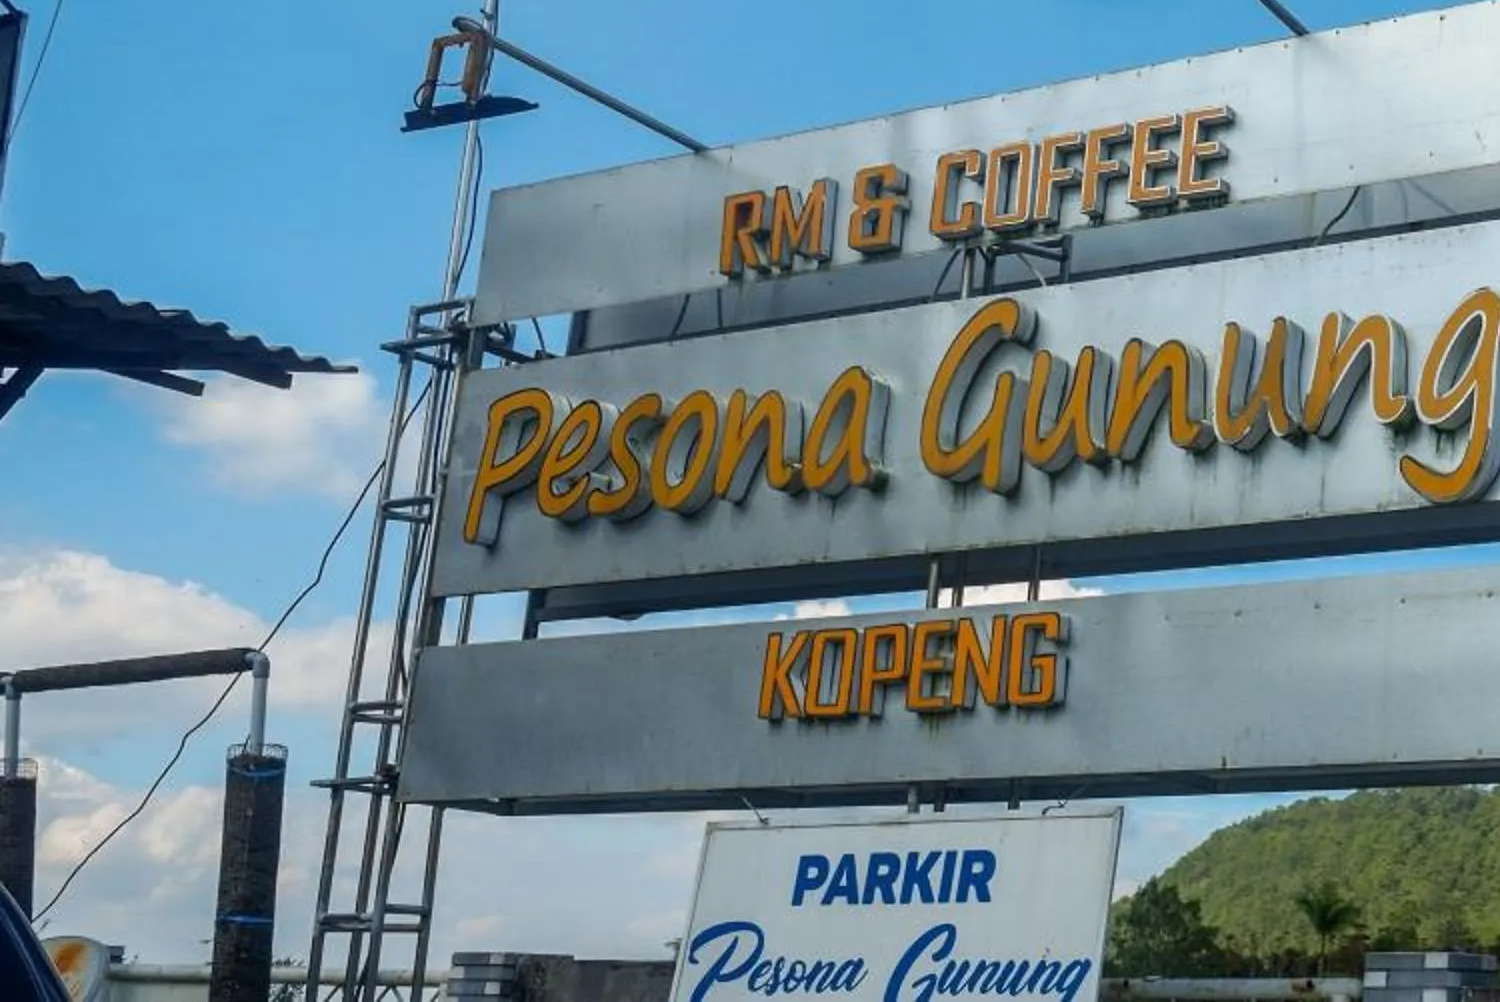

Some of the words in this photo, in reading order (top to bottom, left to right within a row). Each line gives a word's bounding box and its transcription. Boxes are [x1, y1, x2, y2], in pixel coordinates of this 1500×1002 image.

[720, 177, 837, 277] RM
[848, 163, 909, 254] &
[929, 105, 1235, 240] COFFEE
[463, 365, 890, 546] Pesona
[758, 611, 1070, 724] KOPENG
[791, 848, 998, 907] PARKIR
[688, 921, 869, 1002] Pesona
[883, 923, 1093, 1002] Gunung
